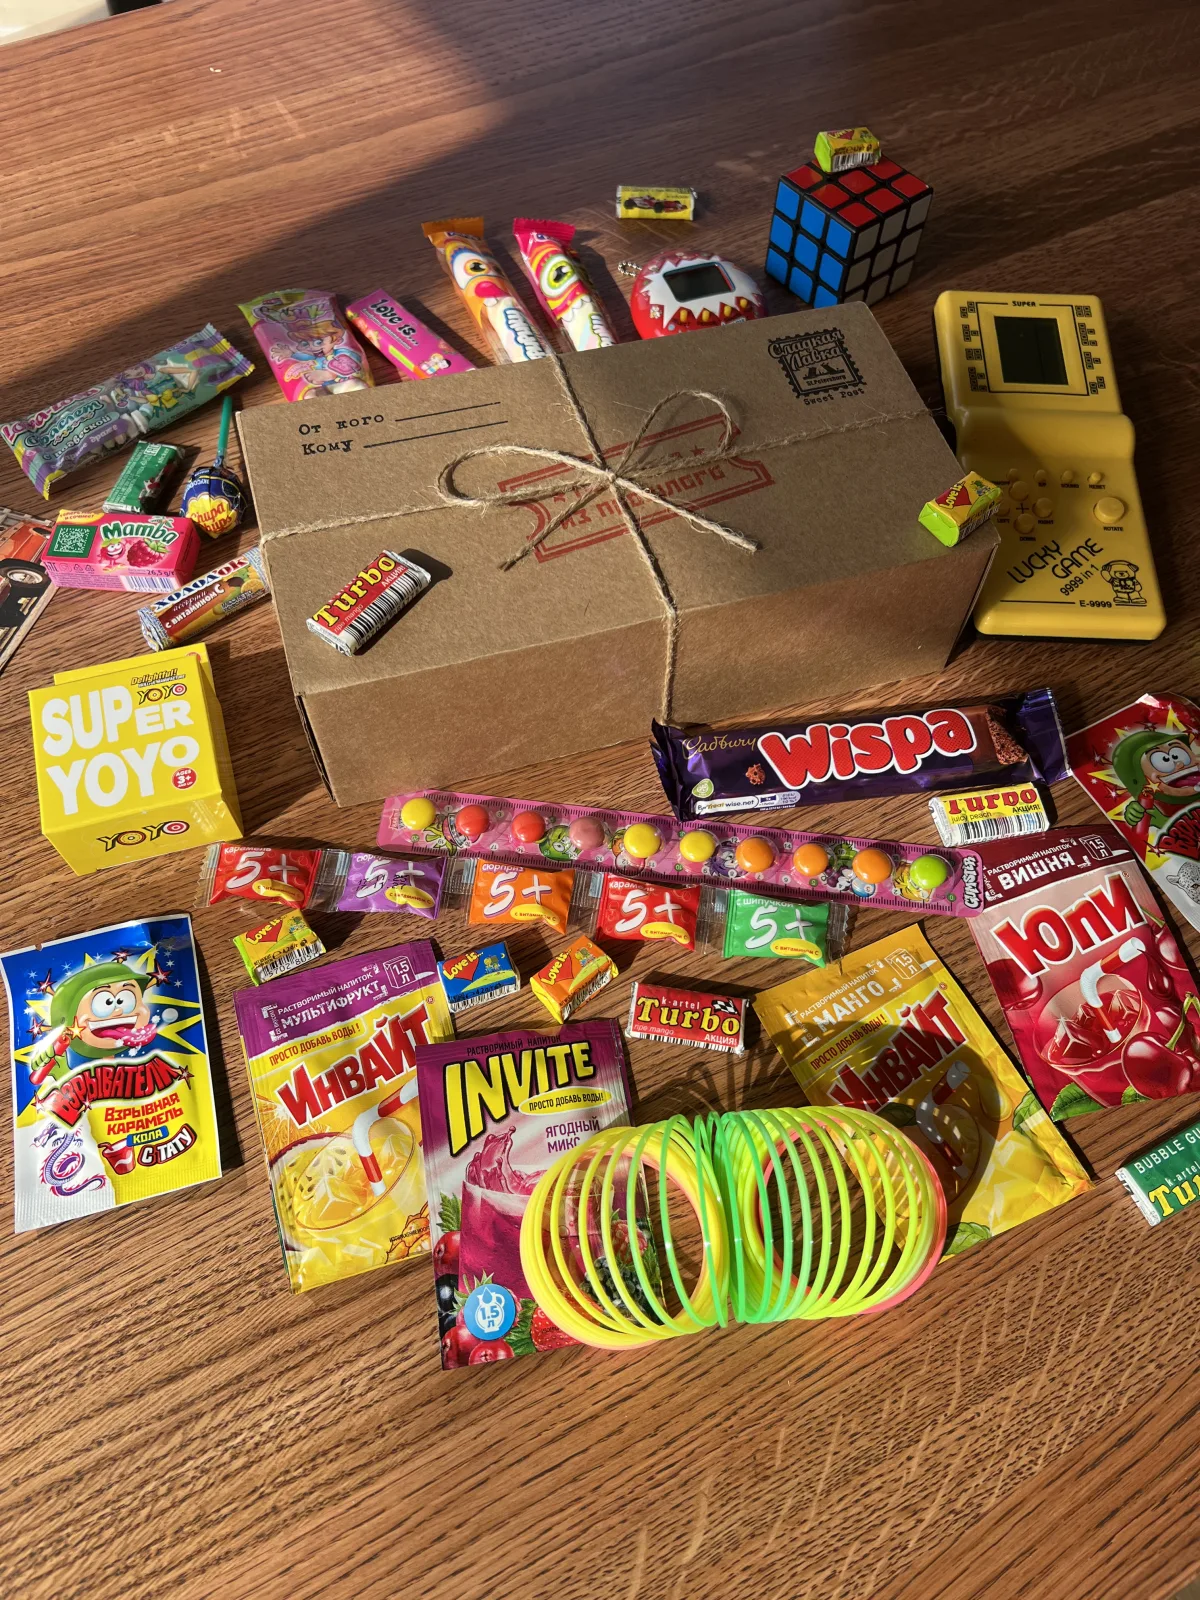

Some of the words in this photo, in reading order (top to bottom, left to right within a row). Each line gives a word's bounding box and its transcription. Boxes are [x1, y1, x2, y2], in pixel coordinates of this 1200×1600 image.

[768, 330, 844, 359] Сладкая
[790, 346, 842, 372] Лавка
[803, 392, 835, 406] Sweet
[839, 387, 865, 399] Post
[298, 423, 322, 436] От
[335, 414, 385, 430] кого
[301, 439, 354, 456] Кому
[100, 520, 180, 546] Mamba
[1007, 540, 1063, 584] LUCKY
[1051, 538, 1104, 579] GAME
[312, 556, 397, 627] Turbo
[1059, 576, 1085, 597] 9999
[1082, 568, 1094, 581] in
[1090, 563, 1100, 572] 1
[171, 591, 218, 625] витамином
[1079, 600, 1113, 608] E-9999
[131, 668, 178, 686] Delightful!
[41, 685, 195, 757] SUPER
[682, 734, 759, 761] Cadbury
[758, 708, 978, 791] Wispa
[46, 735, 200, 816] YOYO
[177, 774, 192, 785] 3+
[943, 788, 1038, 815] Turbo
[969, 811, 993, 821] peach
[1012, 804, 1041, 814] АКЦИЯ!
[226, 851, 299, 890] 5+
[482, 863, 525, 873] сюрприз
[987, 852, 1041, 876] РАСТВОРИМЫЙ
[1040, 843, 1072, 857] НАПИТОК
[998, 852, 1076, 891] ВИШНЯ
[356, 859, 425, 899] 5+
[483, 871, 553, 919] 5+
[615, 889, 682, 933] 5+
[246, 924, 273, 946] Love
[745, 906, 814, 950] 5+
[392, 961, 410, 974] 1.5
[443, 958, 469, 981] Love
[540, 960, 563, 986] Love
[895, 953, 913, 968] 1.5
[277, 985, 337, 1015] РАСТВОРИМЫЙ
[337, 972, 373, 993] НАПИТОК
[281, 980, 380, 1029] МУЛЬТИФРУКТ
[799, 982, 850, 1019] РАСТВОРИМЫЙ
[848, 967, 880, 990] НАПИТОК
[812, 980, 885, 1033] МАНГО
[636, 995, 741, 1036] Turbo
[649, 1025, 675, 1036] mango
[704, 1033, 738, 1046] АКЦИЯ!
[269, 1045, 299, 1067] ПРОСТО
[299, 1035, 332, 1054] ДОБАВЬ
[466, 1039, 523, 1056] РАСТВОРИМЫЙ
[527, 1035, 561, 1047] НАПИТОК
[809, 1049, 838, 1071] ПРОСТО
[836, 1030, 864, 1054] ДОБАВЬ
[51, 1056, 181, 1127] ВЗРЫВАТЕЛИ
[443, 1040, 596, 1156] INVITE
[529, 1098, 554, 1111] ПРОСТО
[555, 1095, 582, 1107] ДОБАВЬ
[582, 1092, 604, 1104] ВОДЫ!
[104, 1092, 181, 1122] ВЗРЫВНАЯ
[107, 1107, 184, 1136] КАРАМЕЛЬ
[132, 1128, 165, 1144] КОЛА
[545, 1116, 600, 1139] ЯГОДНЫЙ
[156, 1126, 193, 1161] ТАТУ
[1134, 1139, 1185, 1174] BUBBLE
[480, 1305, 500, 1321] 1.5
